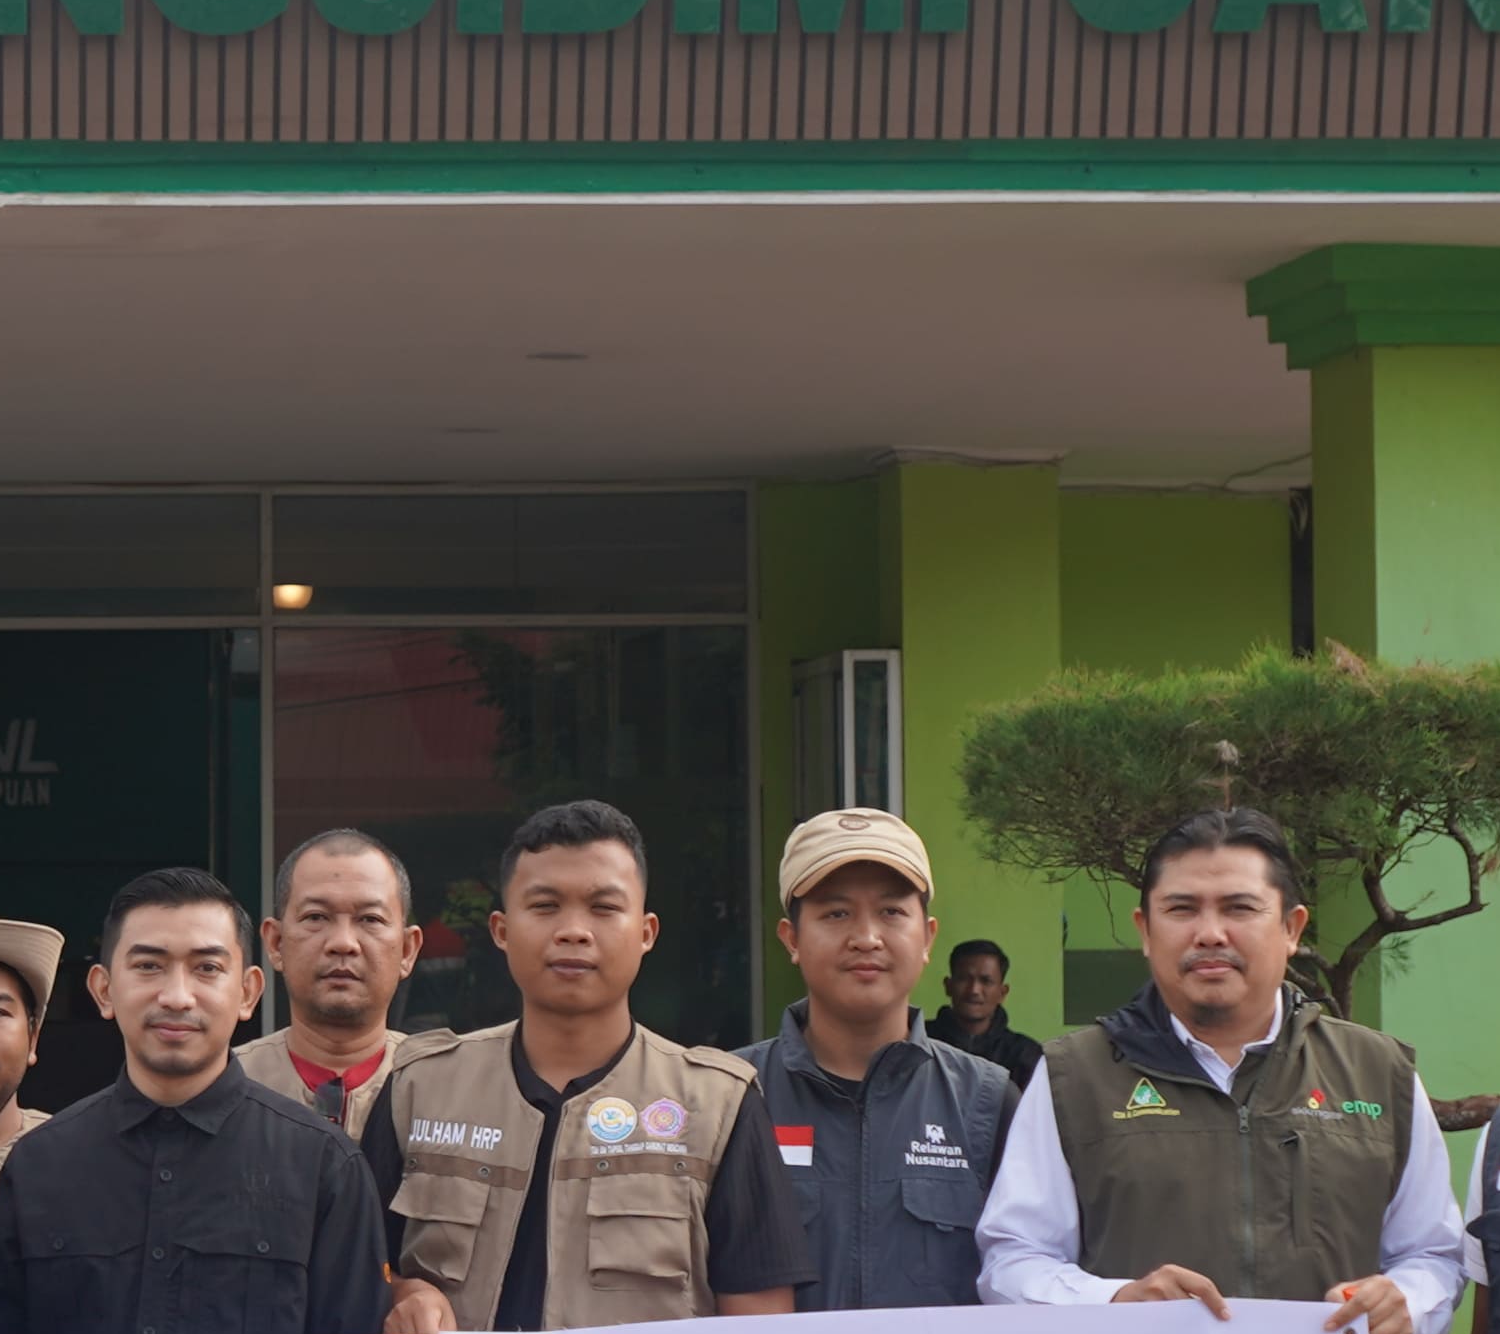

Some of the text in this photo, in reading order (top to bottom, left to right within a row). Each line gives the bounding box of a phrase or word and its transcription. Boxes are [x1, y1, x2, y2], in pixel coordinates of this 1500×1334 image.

[1342, 1099, 1383, 1120] emp
[408, 1118, 503, 1151] JULHAM HRP
[910, 1140, 963, 1156] Relawan
[904, 1152, 970, 1169] Nusantara
